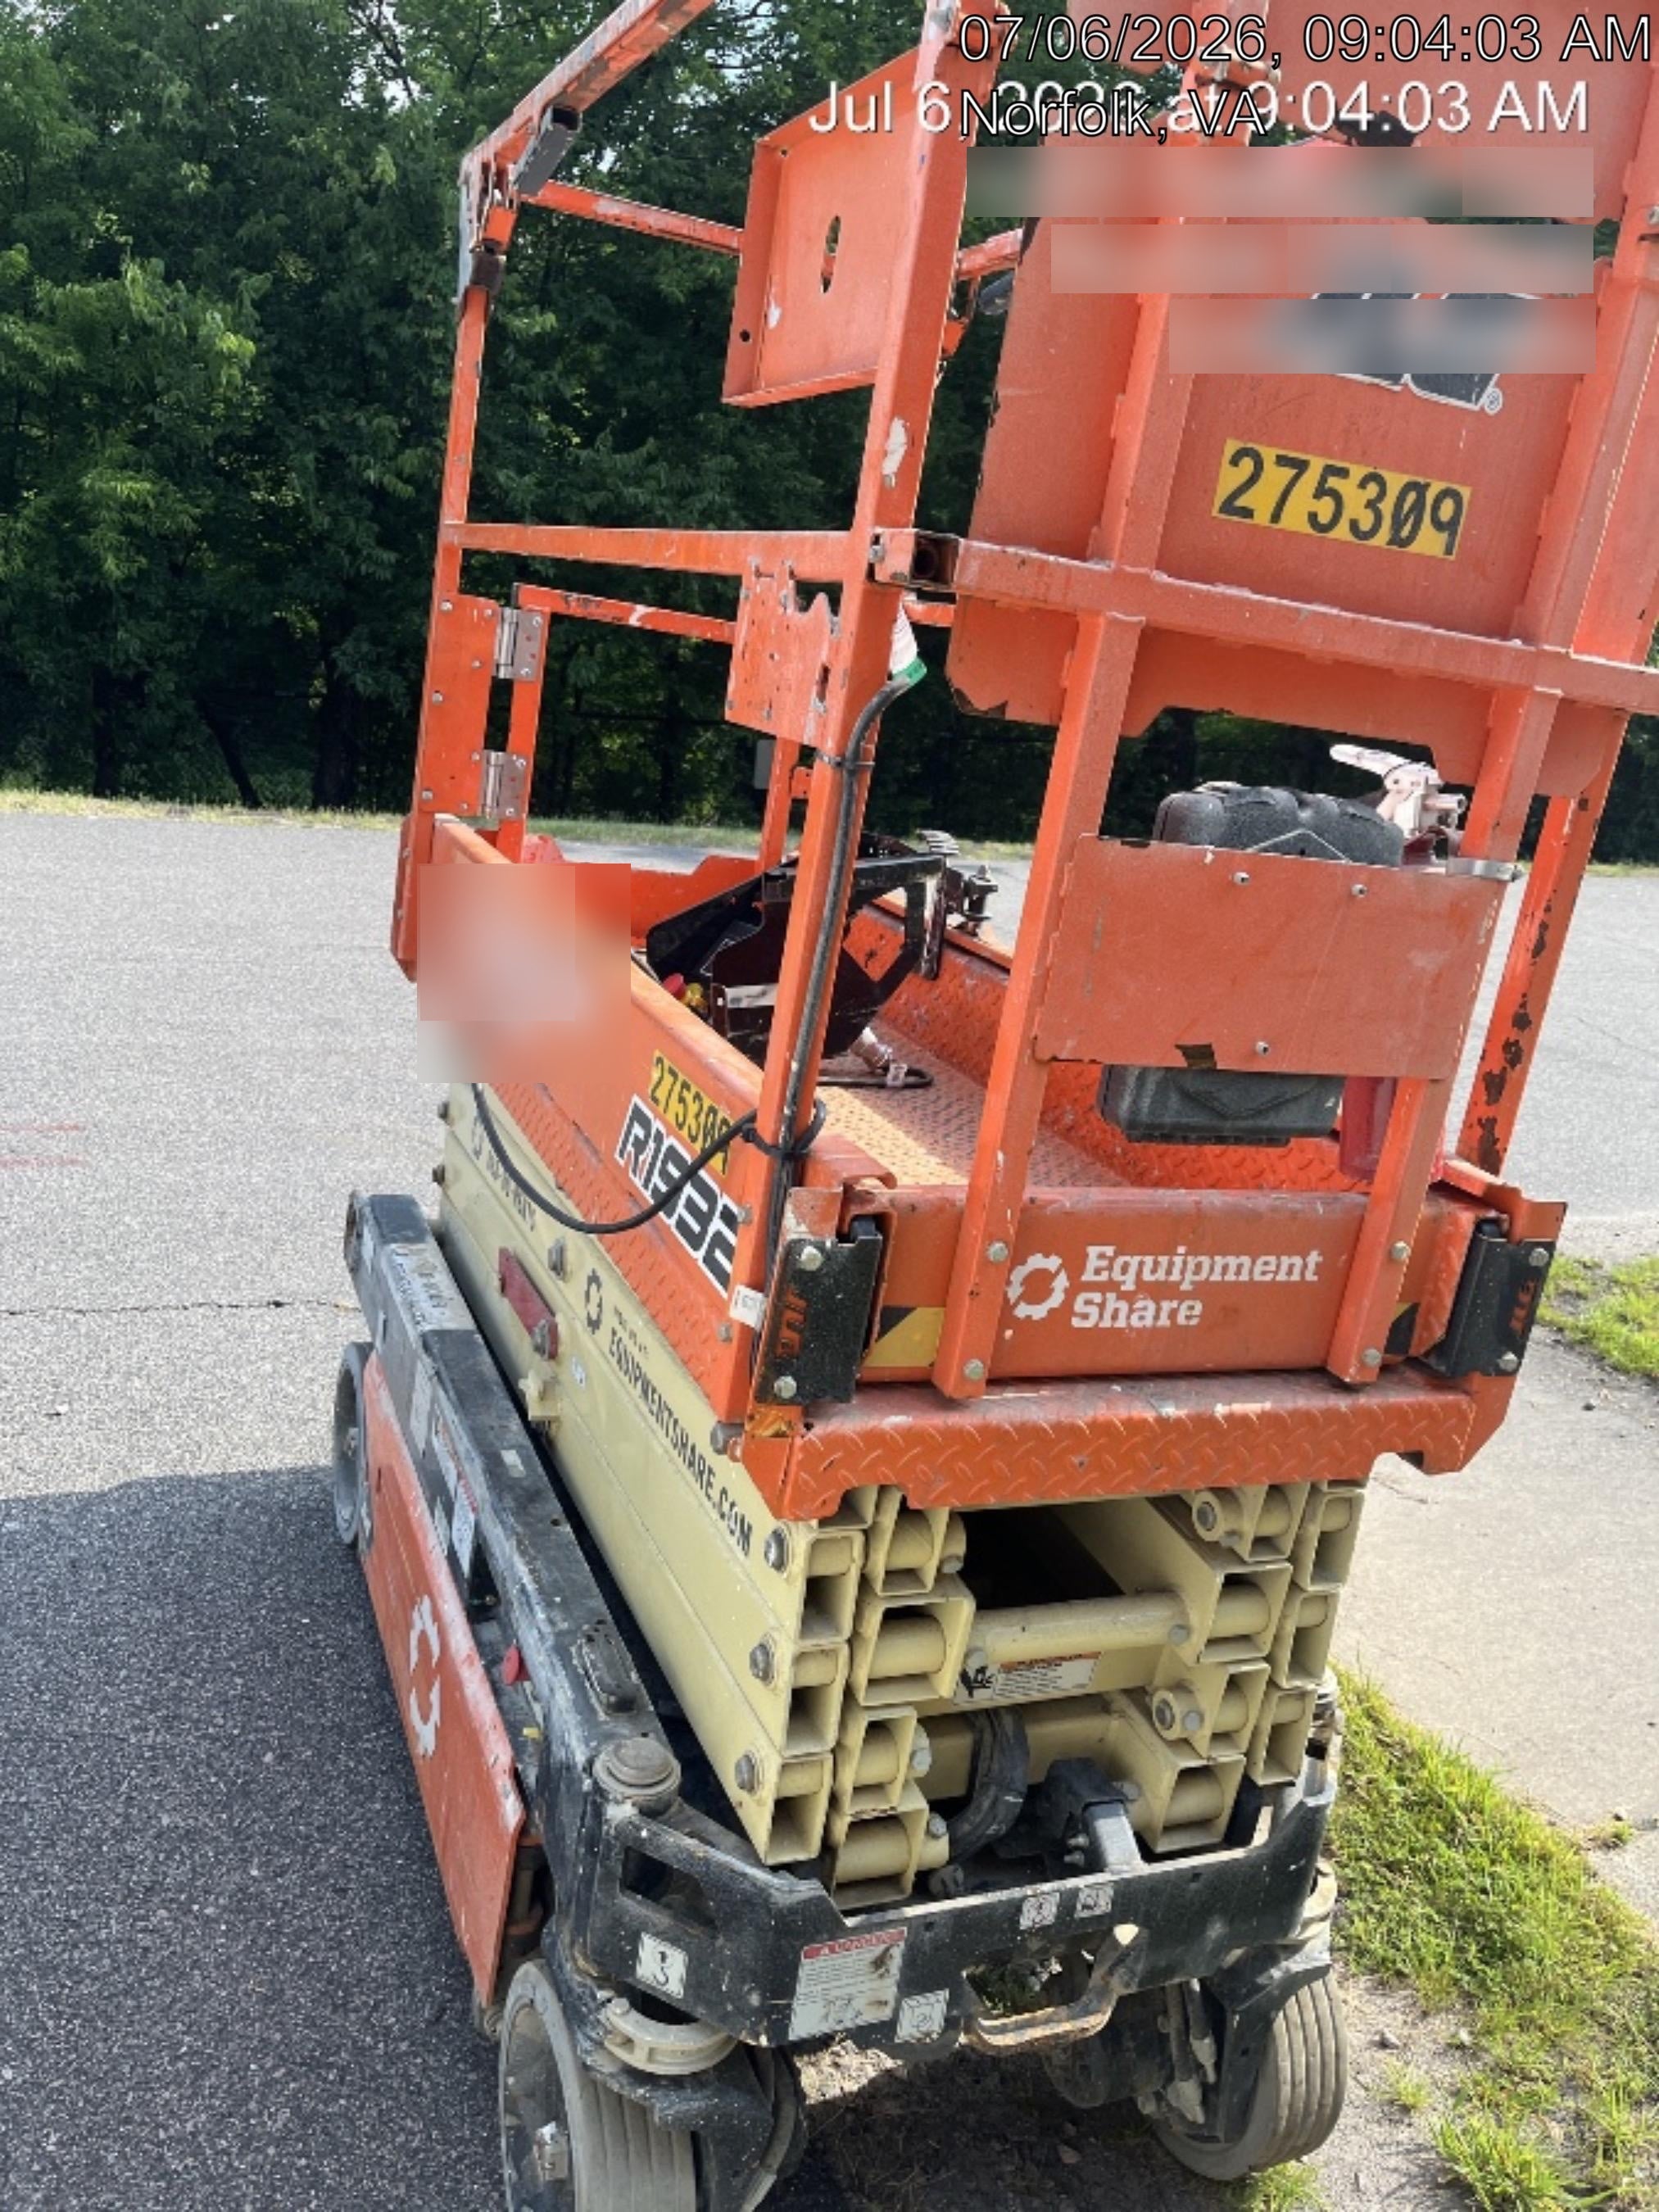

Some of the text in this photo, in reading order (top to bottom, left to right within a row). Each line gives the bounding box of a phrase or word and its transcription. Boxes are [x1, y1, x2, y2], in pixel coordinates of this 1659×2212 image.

[1217, 446, 1465, 557] 275309
[1081, 1245, 1324, 1292] Equipment
[1071, 1291, 1203, 1329] Share
[609, 1326, 754, 1557] EQUIPMENTSHARE.COM
